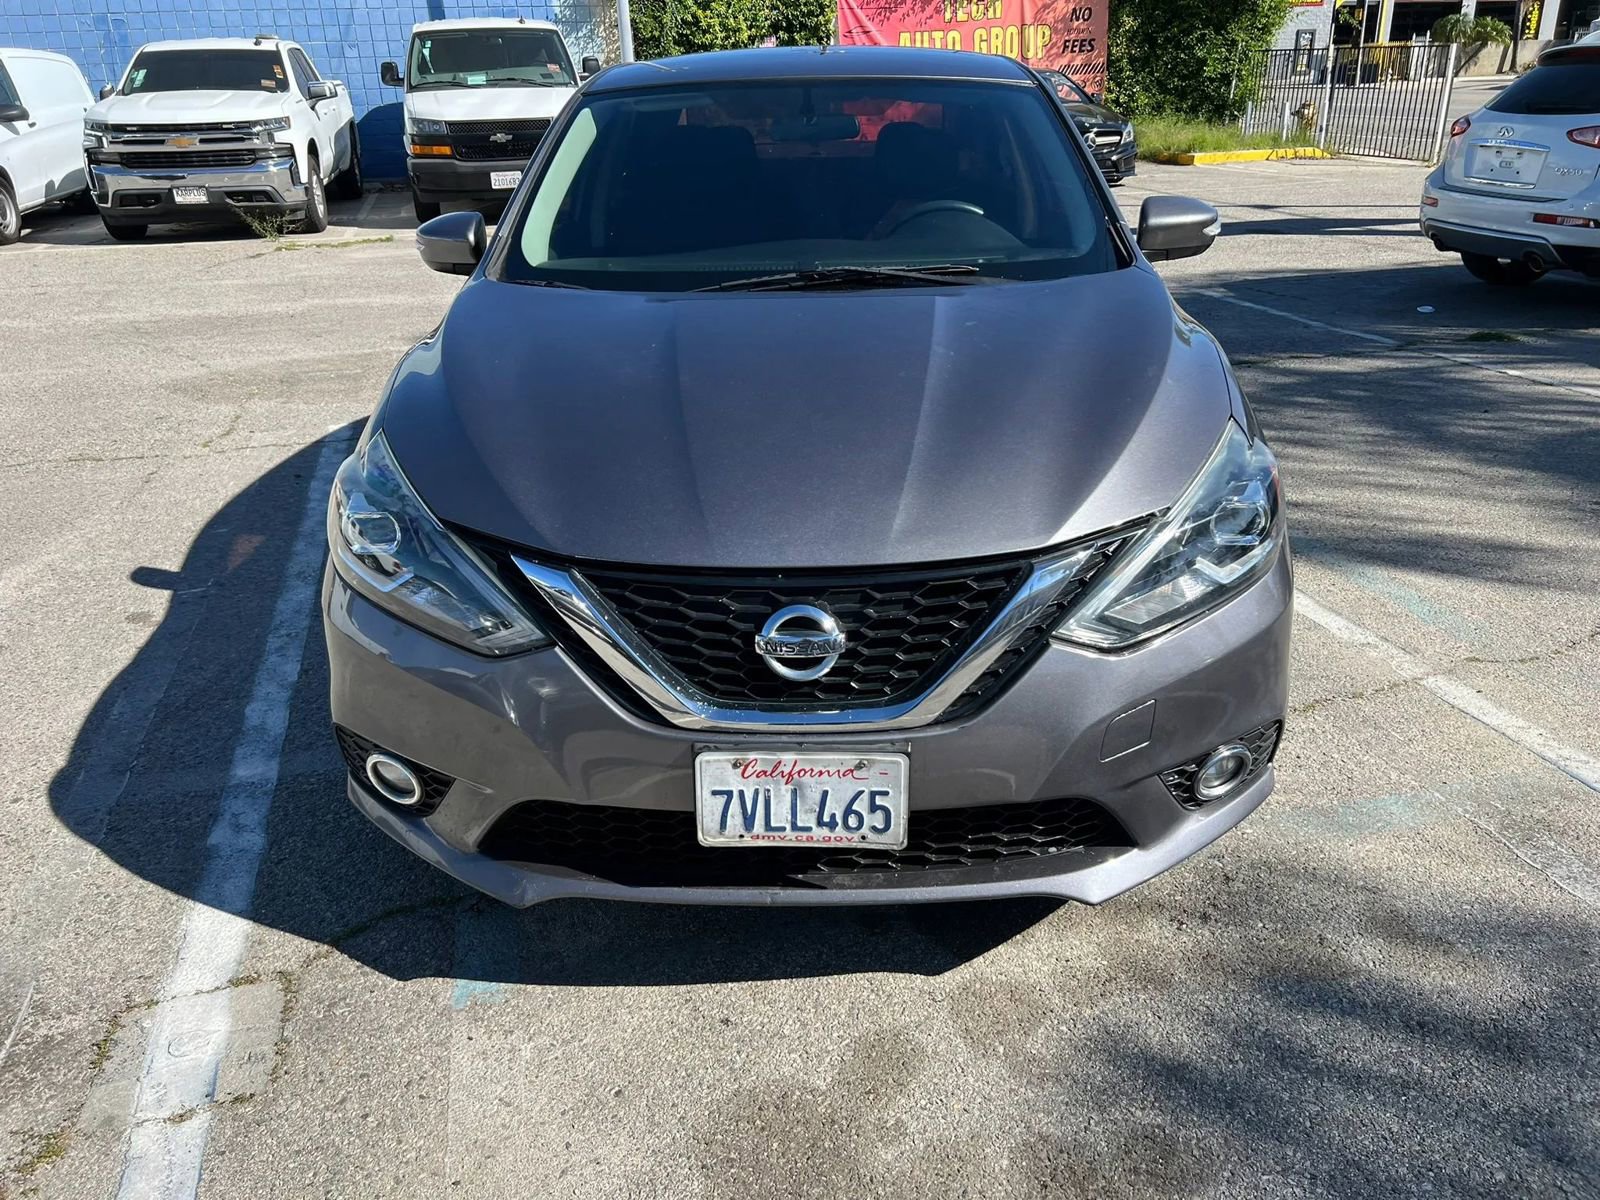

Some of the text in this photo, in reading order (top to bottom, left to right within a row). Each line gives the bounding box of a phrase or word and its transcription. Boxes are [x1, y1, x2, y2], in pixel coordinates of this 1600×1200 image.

[943, 0, 1003, 23] TECH
[1070, 7, 1092, 22] NO
[898, 24, 1052, 60] AUTO GROUP
[1062, 38, 1096, 54] FEES
[764, 638, 838, 655] NISSAN
[741, 758, 869, 785] California
[711, 788, 892, 833] 7VLL465
[750, 834, 855, 843] dmv.ca.gov
